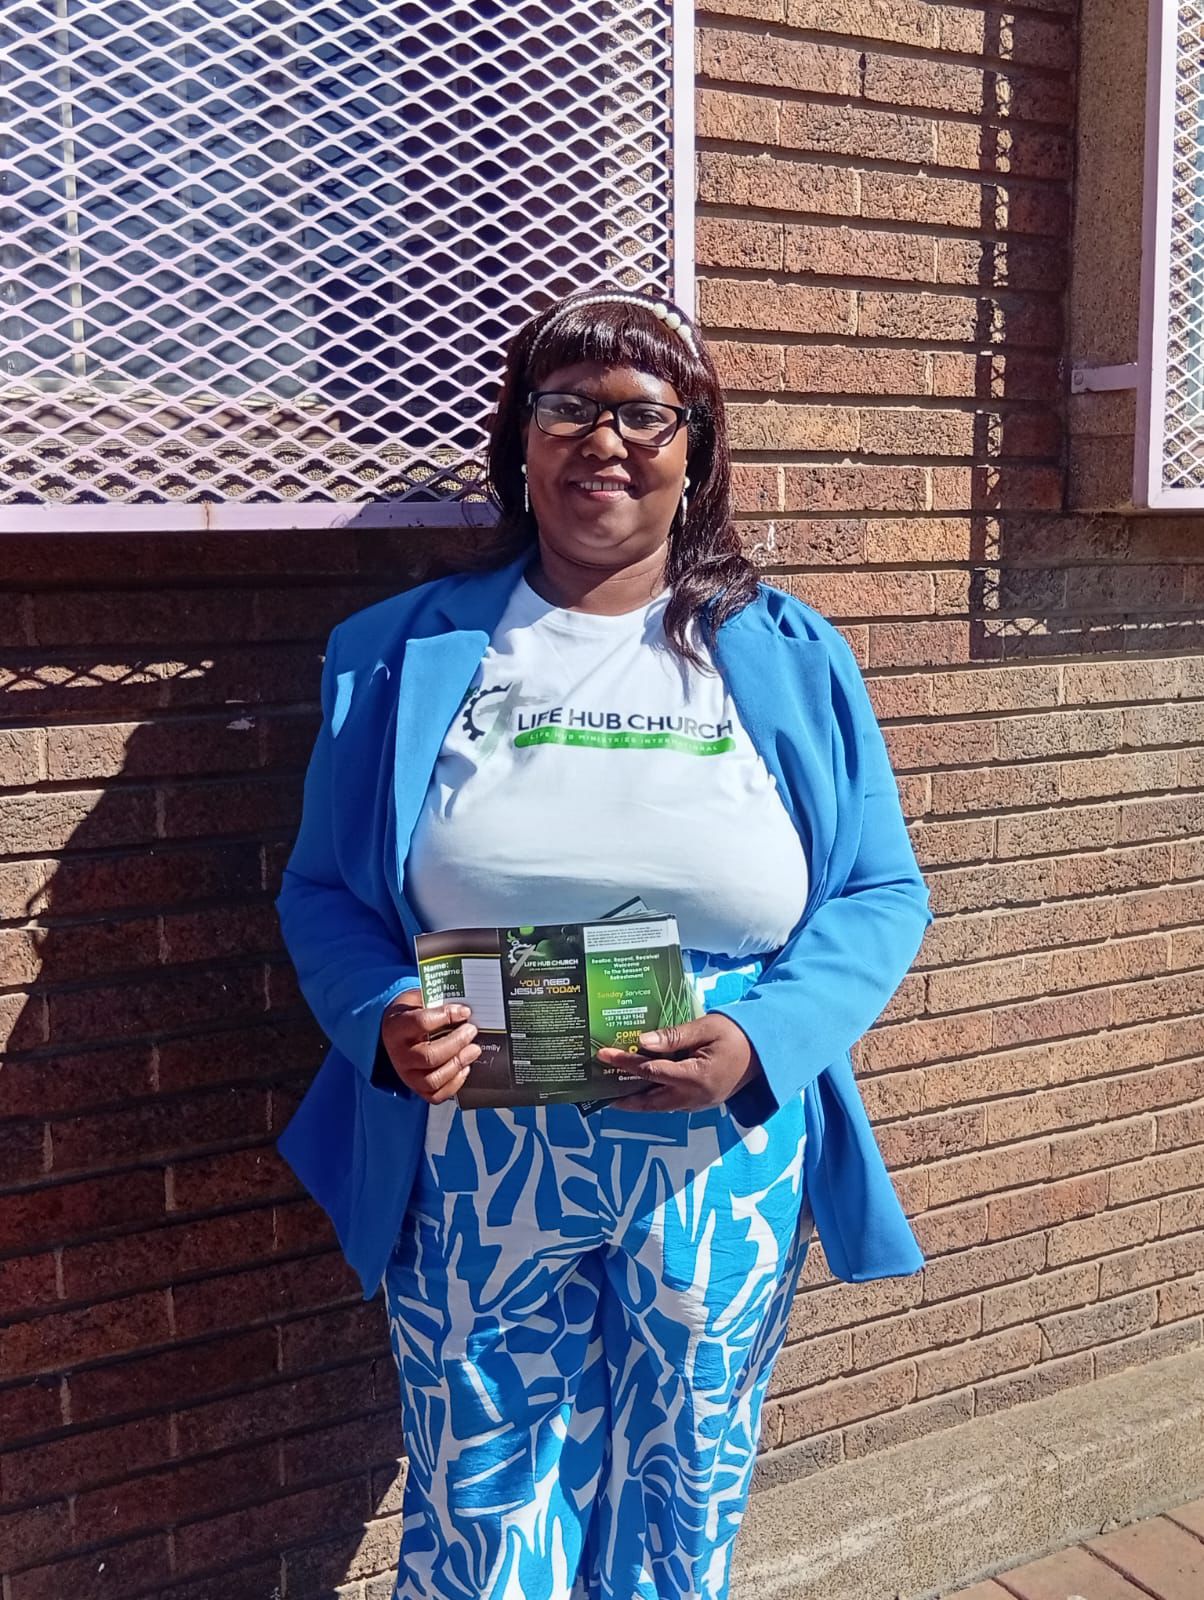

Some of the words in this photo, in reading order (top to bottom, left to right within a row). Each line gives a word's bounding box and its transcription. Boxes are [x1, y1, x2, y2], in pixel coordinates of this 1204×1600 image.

[518, 707, 563, 731] LIFE
[568, 708, 622, 729] HUB
[627, 713, 733, 739] CHURCH
[530, 731, 550, 740] LIFE
[551, 958, 579, 966] CHURCH
[423, 962, 449, 974] Name:
[426, 977, 445, 988] Age:
[520, 979, 540, 987] YOU
[543, 977, 570, 987] NEED
[426, 984, 442, 996] Cell
[443, 983, 458, 991] No:
[510, 986, 544, 996] JESUS
[545, 985, 581, 994] TODAY!
[481, 1044, 501, 1052] amily
